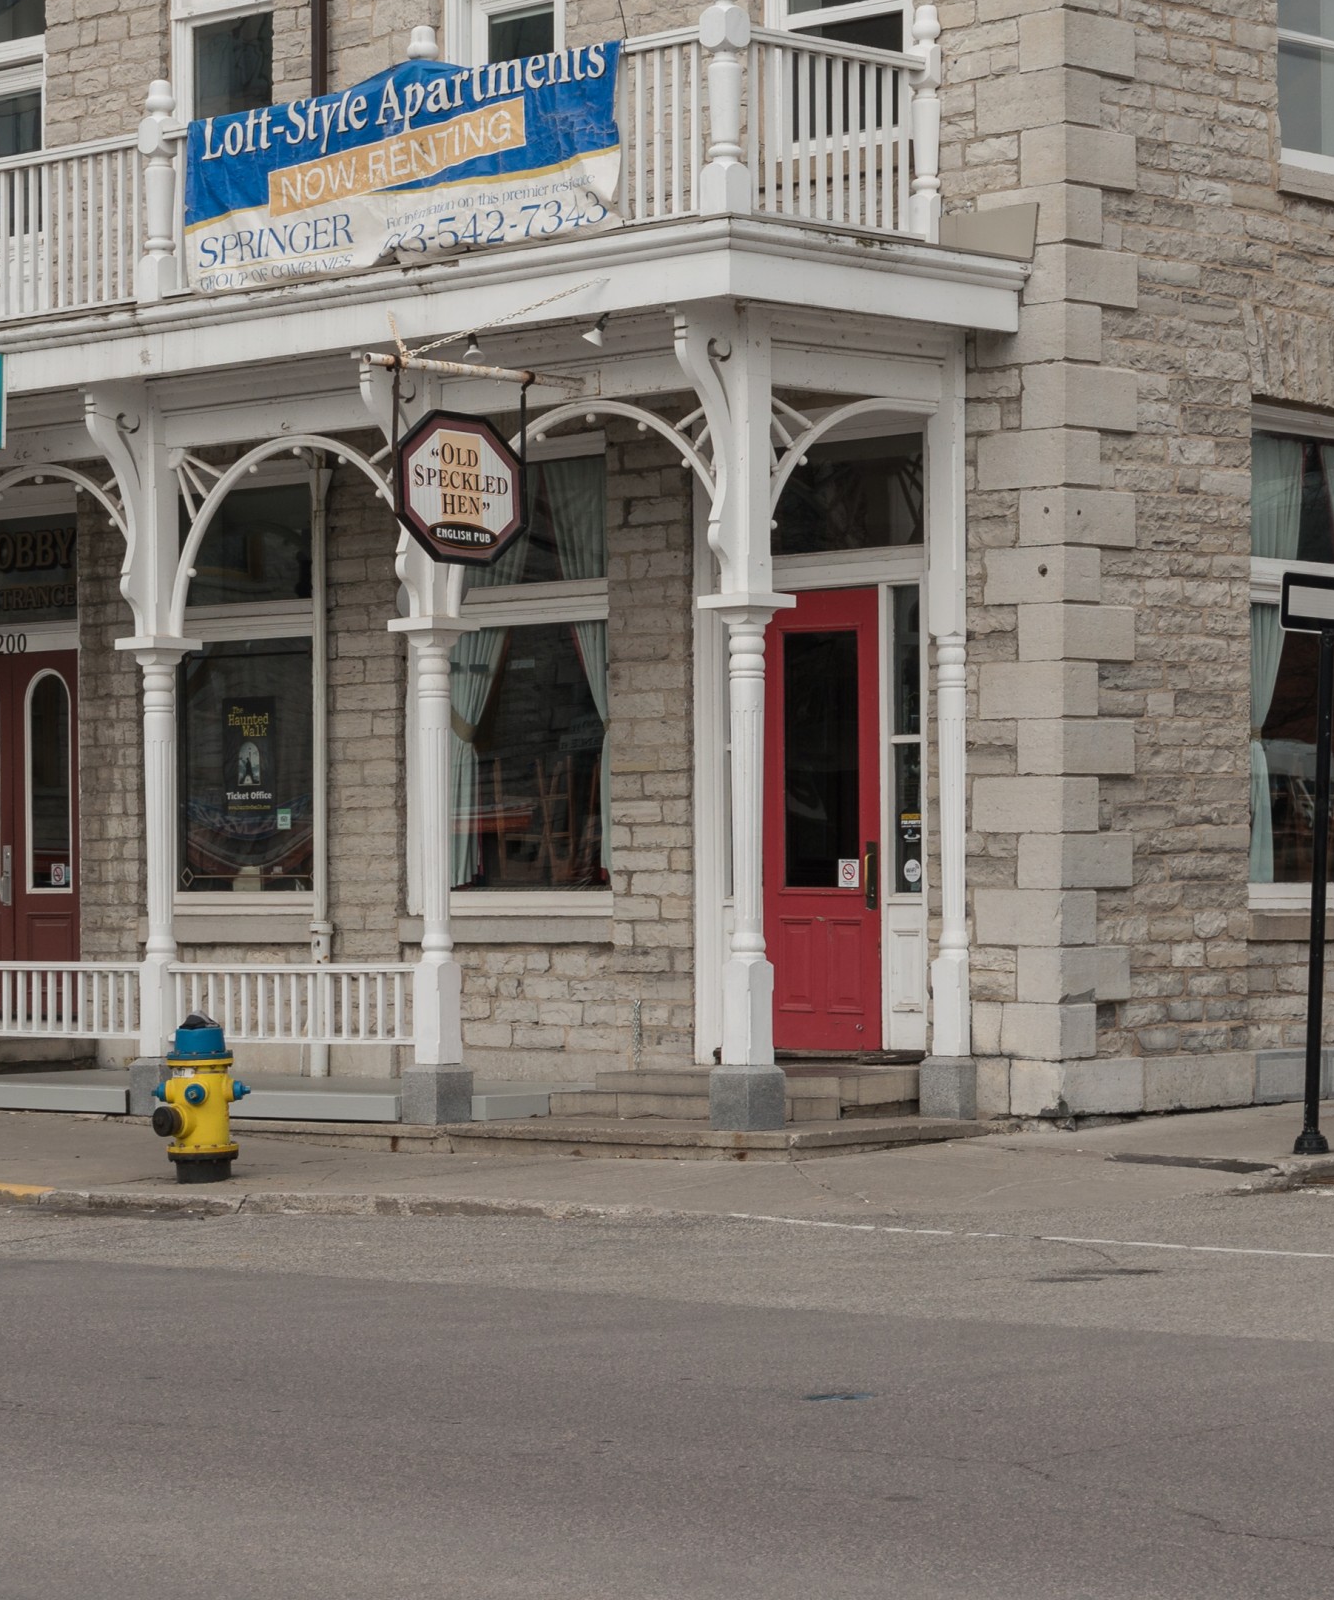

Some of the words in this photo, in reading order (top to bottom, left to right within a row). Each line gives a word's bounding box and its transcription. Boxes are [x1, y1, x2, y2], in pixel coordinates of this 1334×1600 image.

[202, 91, 368, 160] Loft-Style
[375, 43, 606, 133] Apartments
[280, 156, 357, 208] NOW
[367, 110, 512, 184] RENTING
[457, 196, 475, 208] on
[477, 191, 500, 206] this
[502, 184, 550, 203] premier
[199, 213, 355, 269] SPRINGER
[199, 271, 248, 292] GROUP
[251, 267, 268, 284] OF
[271, 254, 354, 279] COMPANIES
[413, 463, 508, 495] SPECKLED
[436, 527, 472, 541] ENGLISH
[473, 531, 491, 543] PUB
[228, 712, 269, 726] Haunted
[232, 706, 244, 714] The
[242, 725, 268, 737] Walk
[226, 791, 249, 800] Ticket
[250, 791, 273, 800] Office
